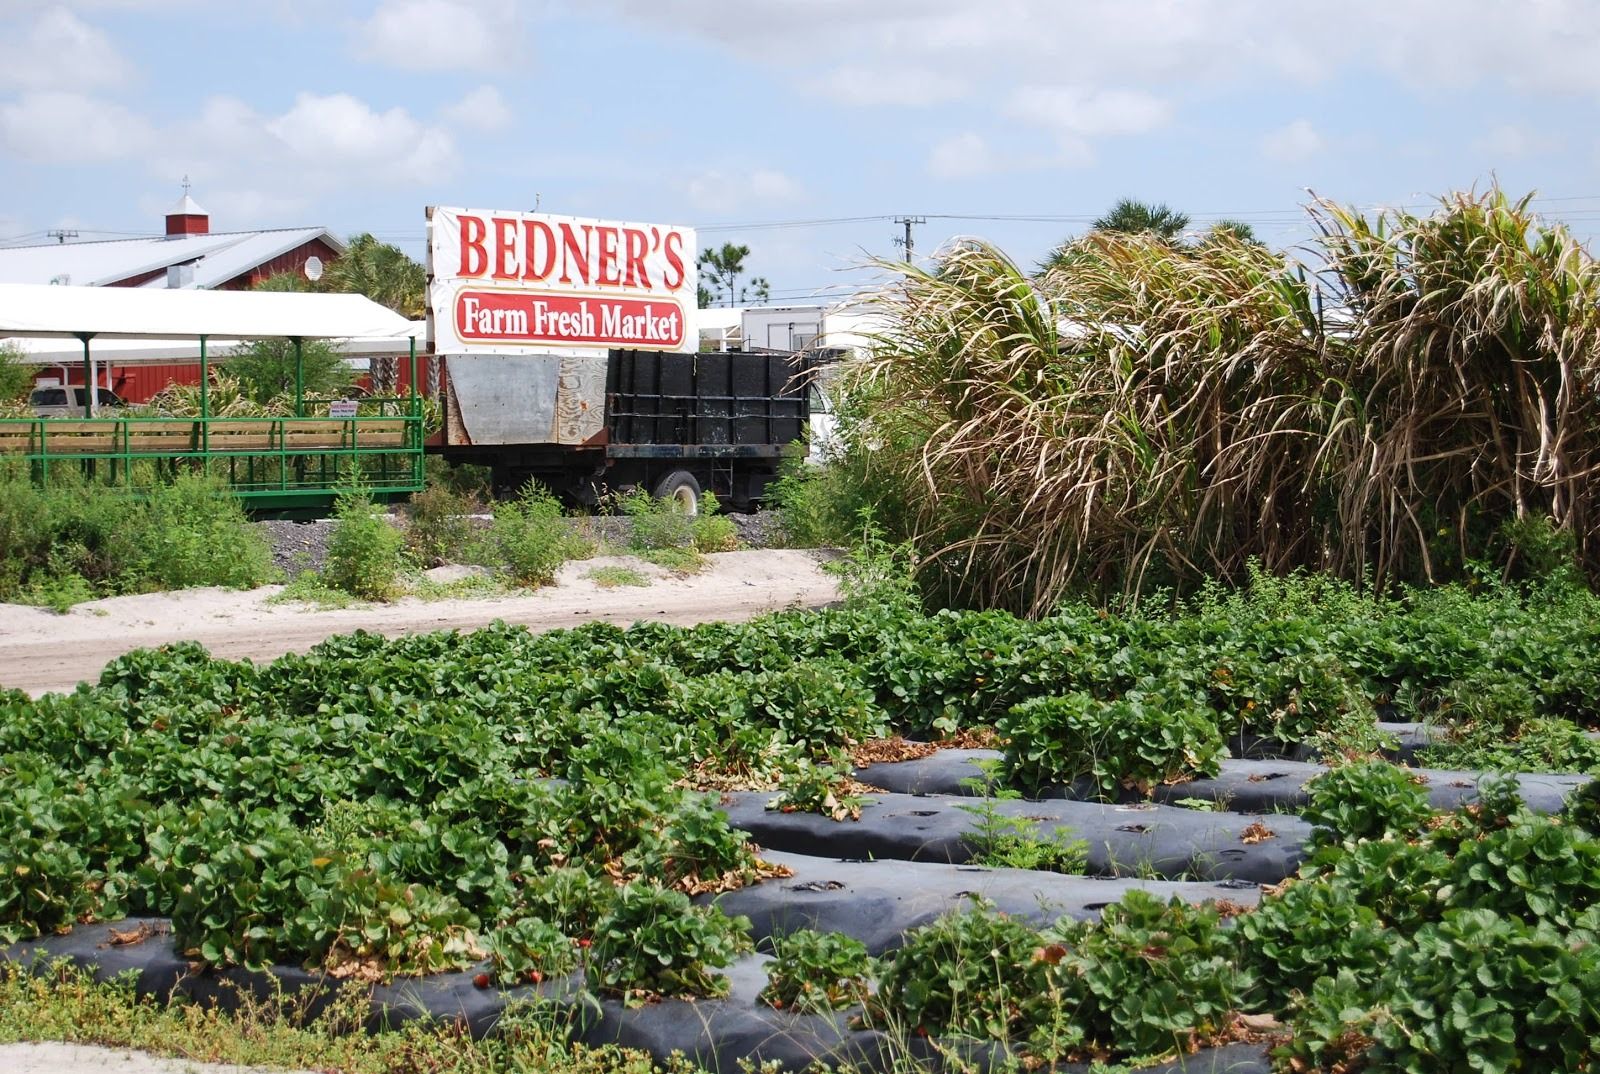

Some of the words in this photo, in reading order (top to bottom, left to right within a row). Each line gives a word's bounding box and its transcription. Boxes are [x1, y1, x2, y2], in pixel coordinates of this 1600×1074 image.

[456, 215, 685, 290] BEDNER'S
[463, 298, 528, 335] Farm
[532, 300, 595, 338] Fresh
[600, 304, 679, 341] Market
